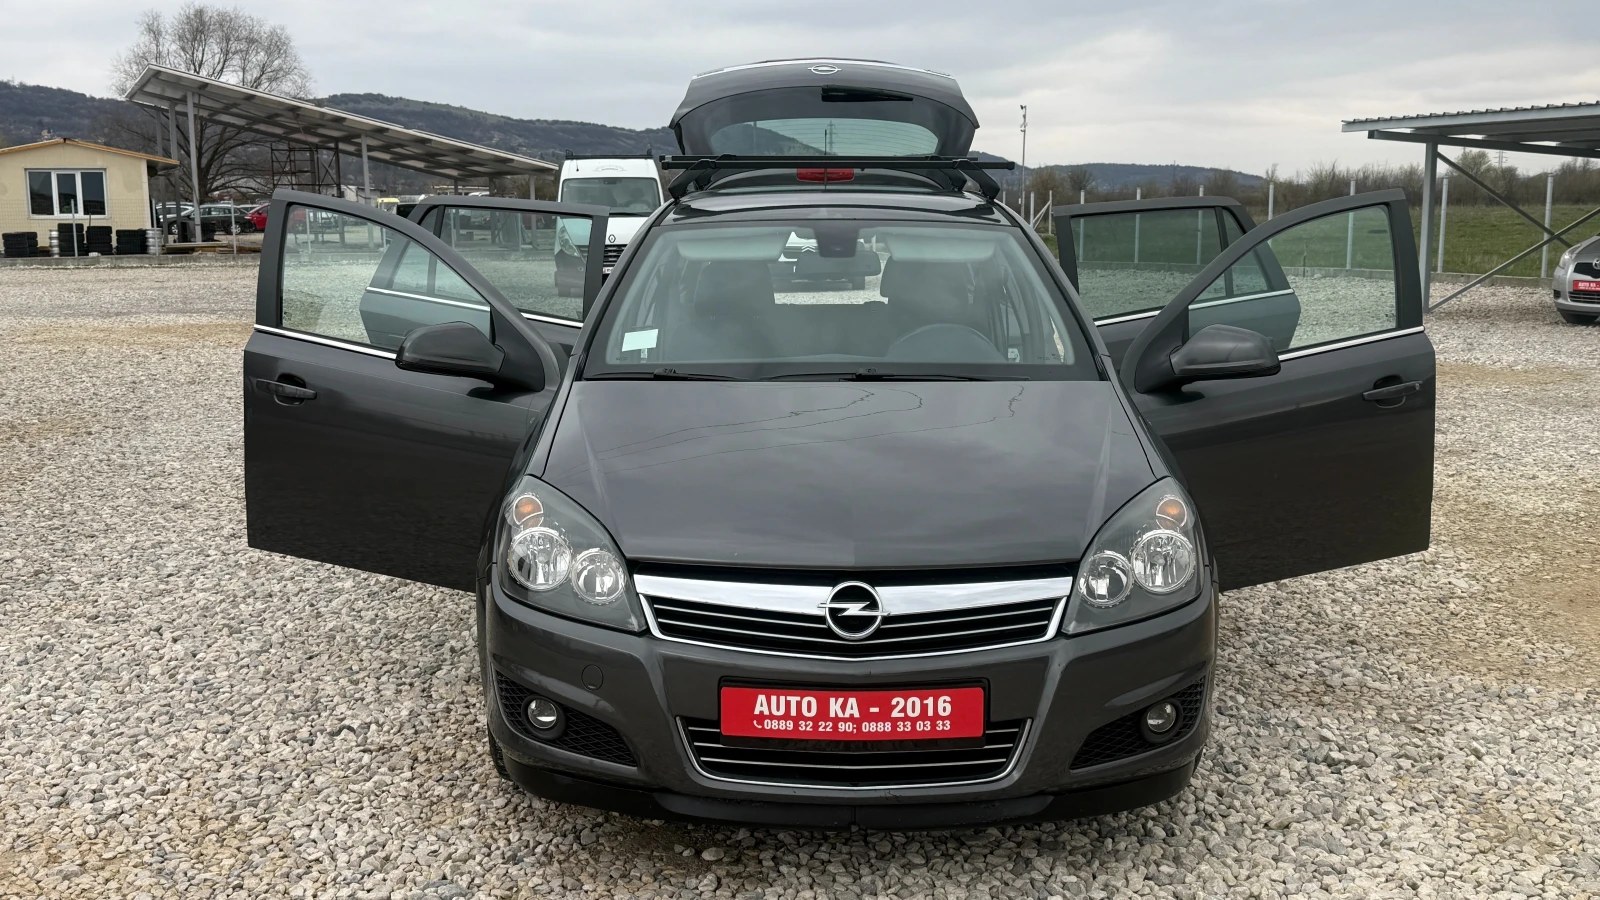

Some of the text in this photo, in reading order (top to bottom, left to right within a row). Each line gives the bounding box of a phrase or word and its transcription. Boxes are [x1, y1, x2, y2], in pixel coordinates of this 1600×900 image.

[753, 694, 818, 717] AUTO
[829, 696, 860, 718] KA
[890, 695, 952, 718] 2016
[763, 719, 951, 734] 0889 32 22 90; 0888 33 03 33
